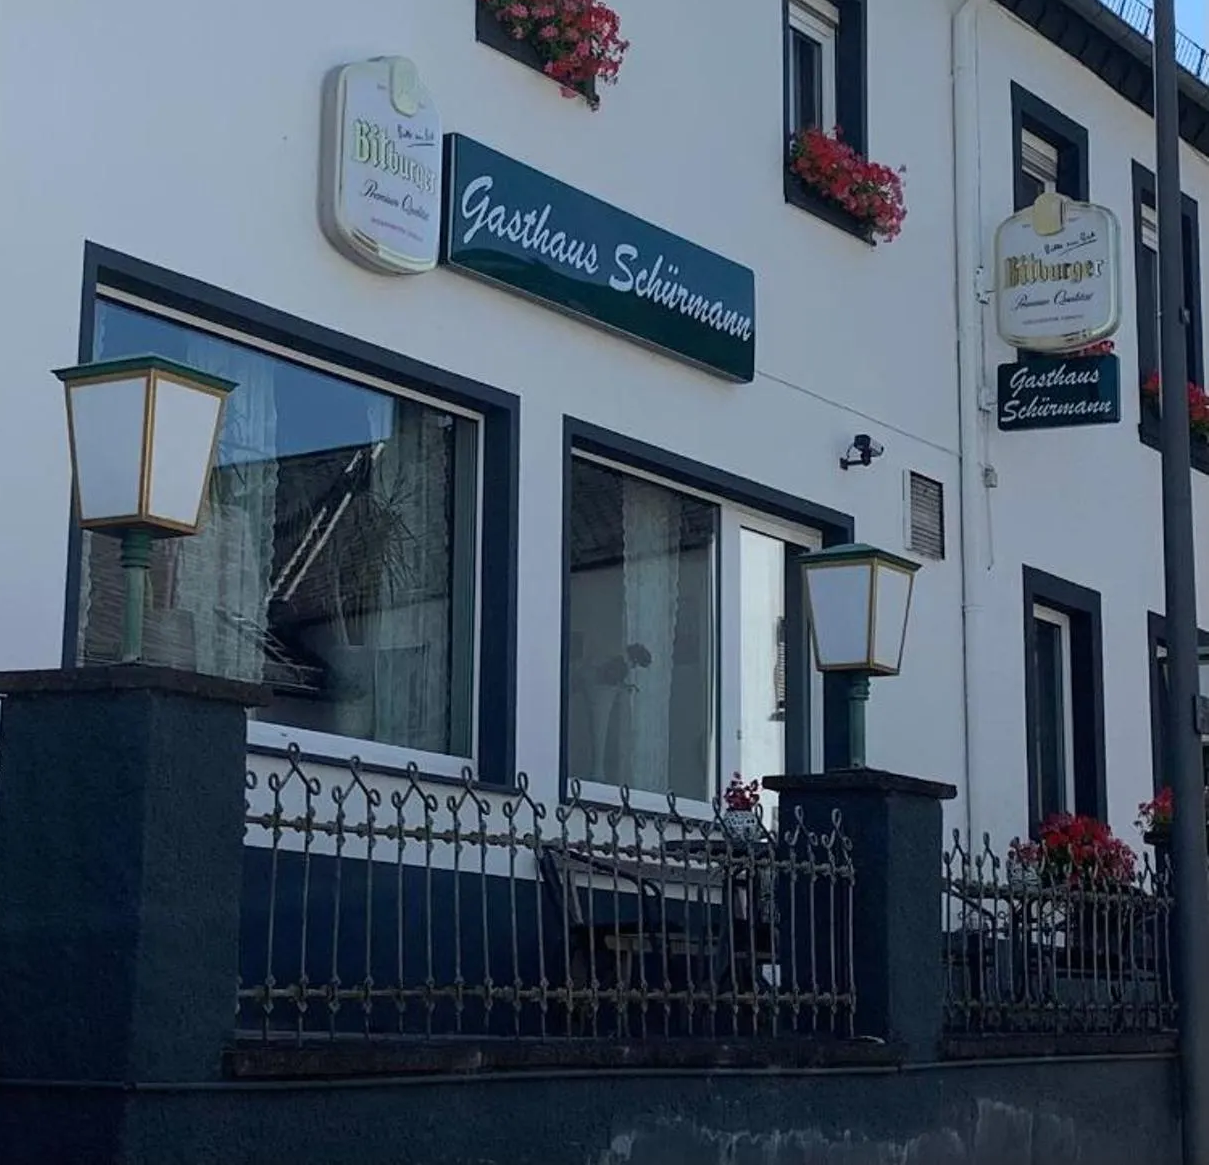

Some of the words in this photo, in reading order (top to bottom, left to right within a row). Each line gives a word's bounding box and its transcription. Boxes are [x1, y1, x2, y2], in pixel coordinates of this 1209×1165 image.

[353, 118, 437, 194] Bitburger
[461, 176, 599, 274] Gasthaus
[608, 243, 752, 342] Schürmann
[1003, 252, 1105, 289] Bitburger
[1009, 364, 1101, 397] Gasthaus
[1000, 396, 1113, 423] Schürmann
